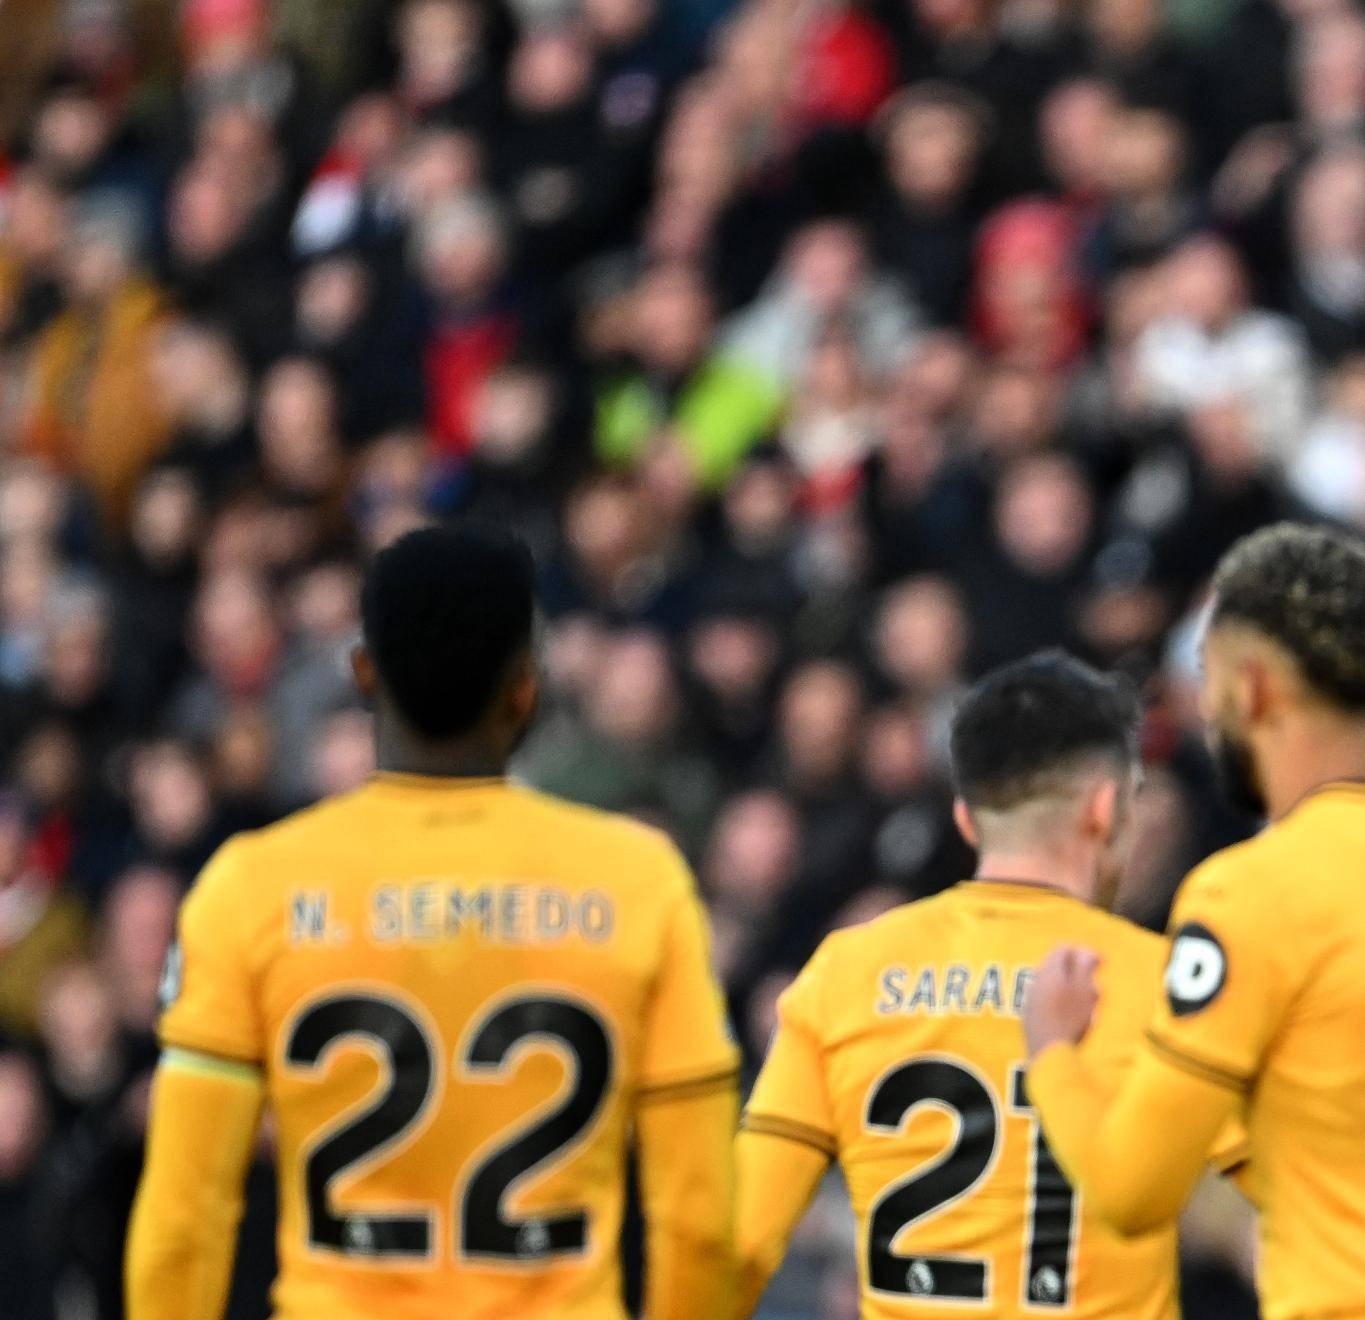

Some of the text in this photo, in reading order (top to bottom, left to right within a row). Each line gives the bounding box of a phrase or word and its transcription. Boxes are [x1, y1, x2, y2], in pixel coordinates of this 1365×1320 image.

[370, 878, 616, 945] SEMEDO
[279, 983, 617, 1265] 22
[863, 1052, 1081, 1310] 21
